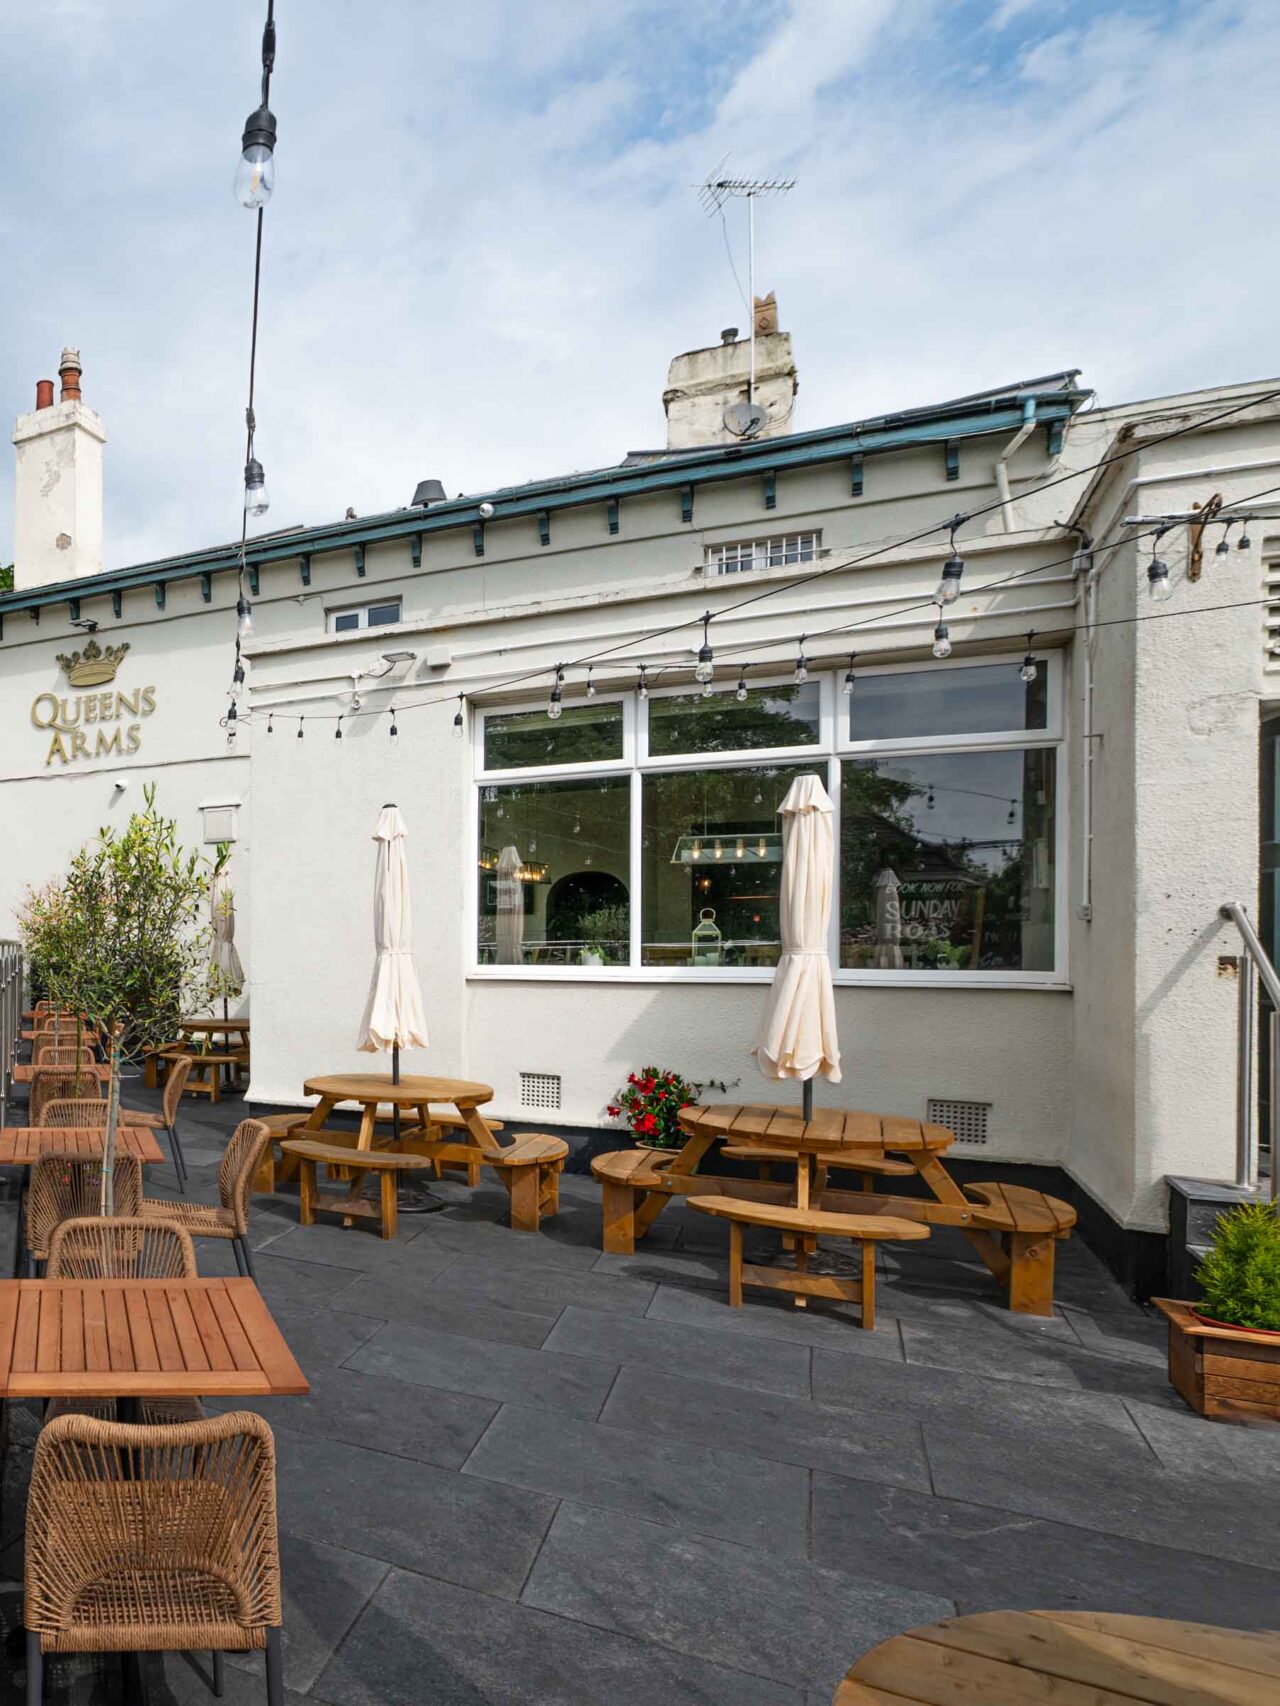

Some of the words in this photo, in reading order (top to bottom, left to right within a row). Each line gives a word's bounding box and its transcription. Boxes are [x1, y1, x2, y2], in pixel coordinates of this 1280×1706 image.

[31, 686, 157, 733] QUEENS
[46, 724, 141, 766] ARMS
[885, 882, 918, 894] BOOK
[919, 882, 943, 894] NOW
[944, 881, 965, 893] FOR
[885, 899, 961, 920] SUNDAY
[883, 922, 956, 939] ROAS
